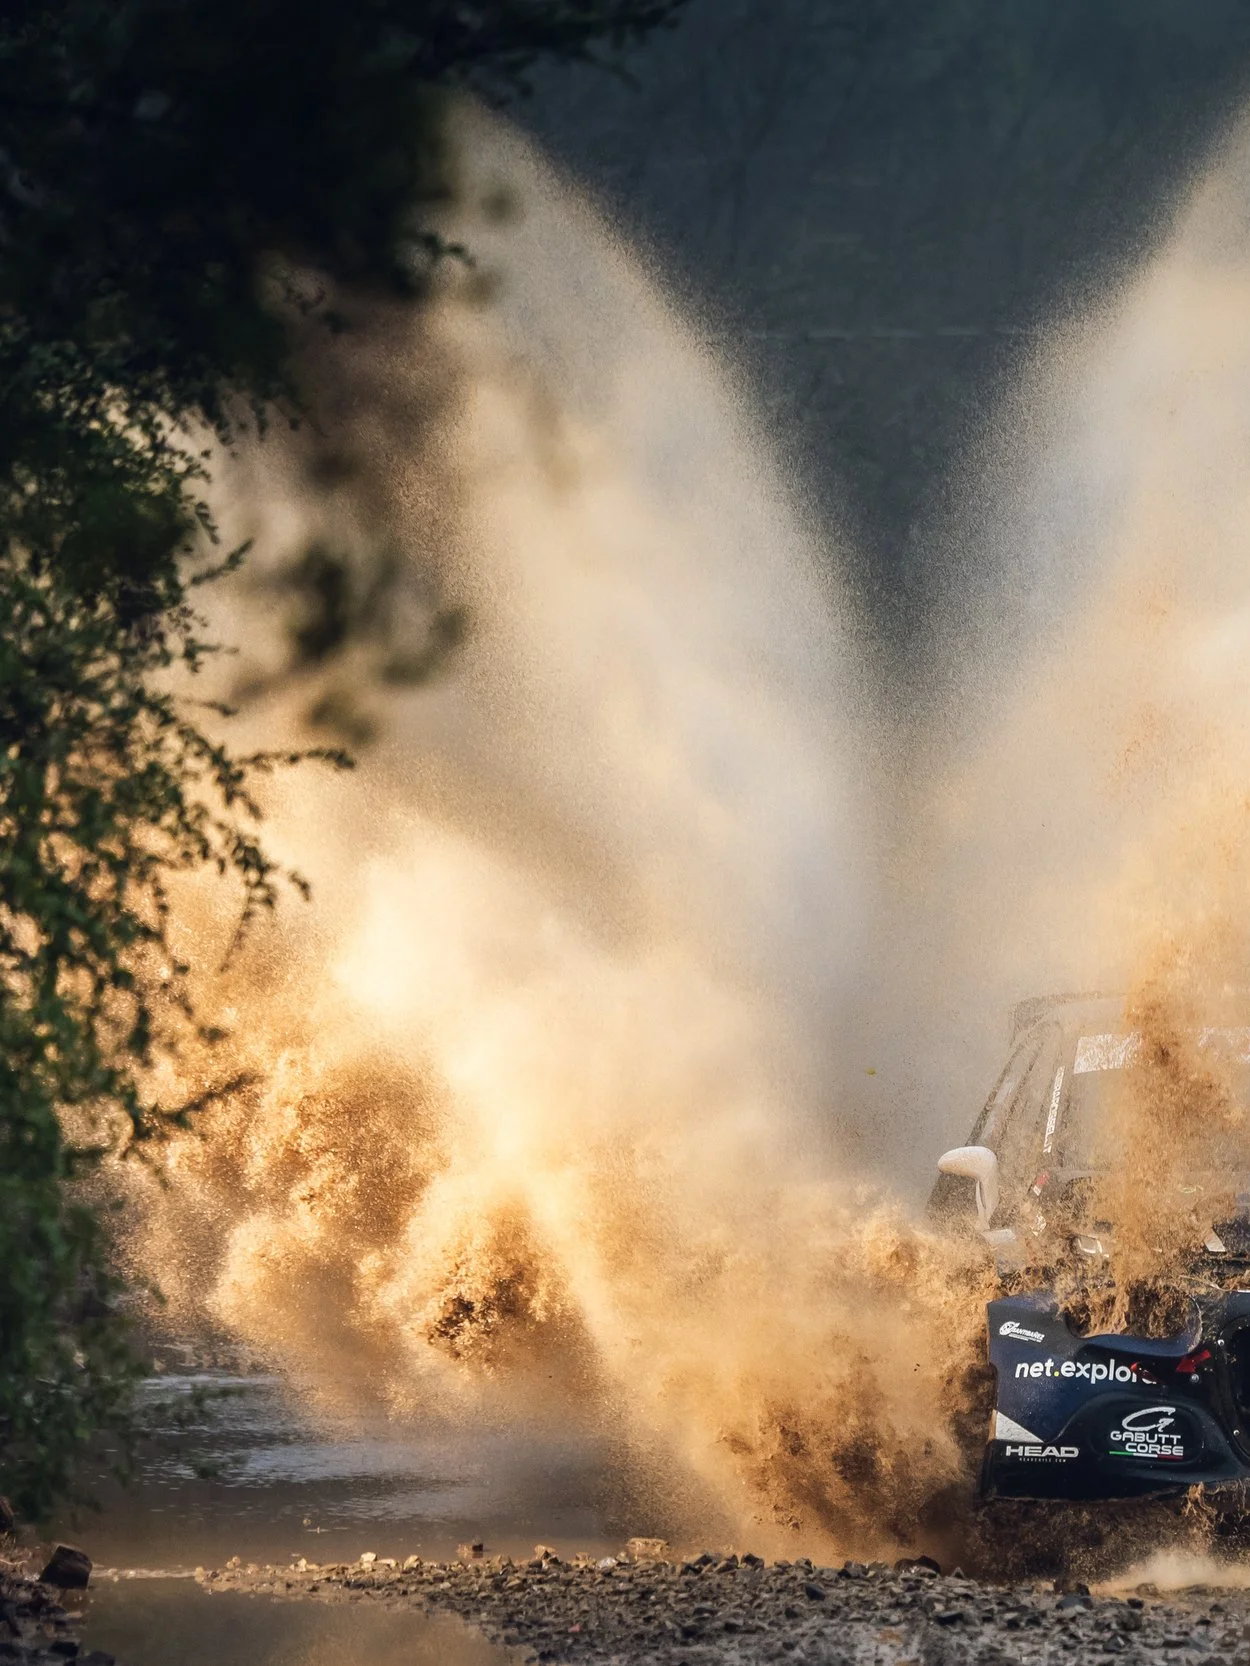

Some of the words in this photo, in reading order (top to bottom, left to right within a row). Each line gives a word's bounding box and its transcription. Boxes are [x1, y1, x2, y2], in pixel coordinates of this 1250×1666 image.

[1110, 1430, 1181, 1445] GABUTT
[1005, 1445, 1080, 1458] HEAD
[1125, 1442, 1184, 1456] CORSE
